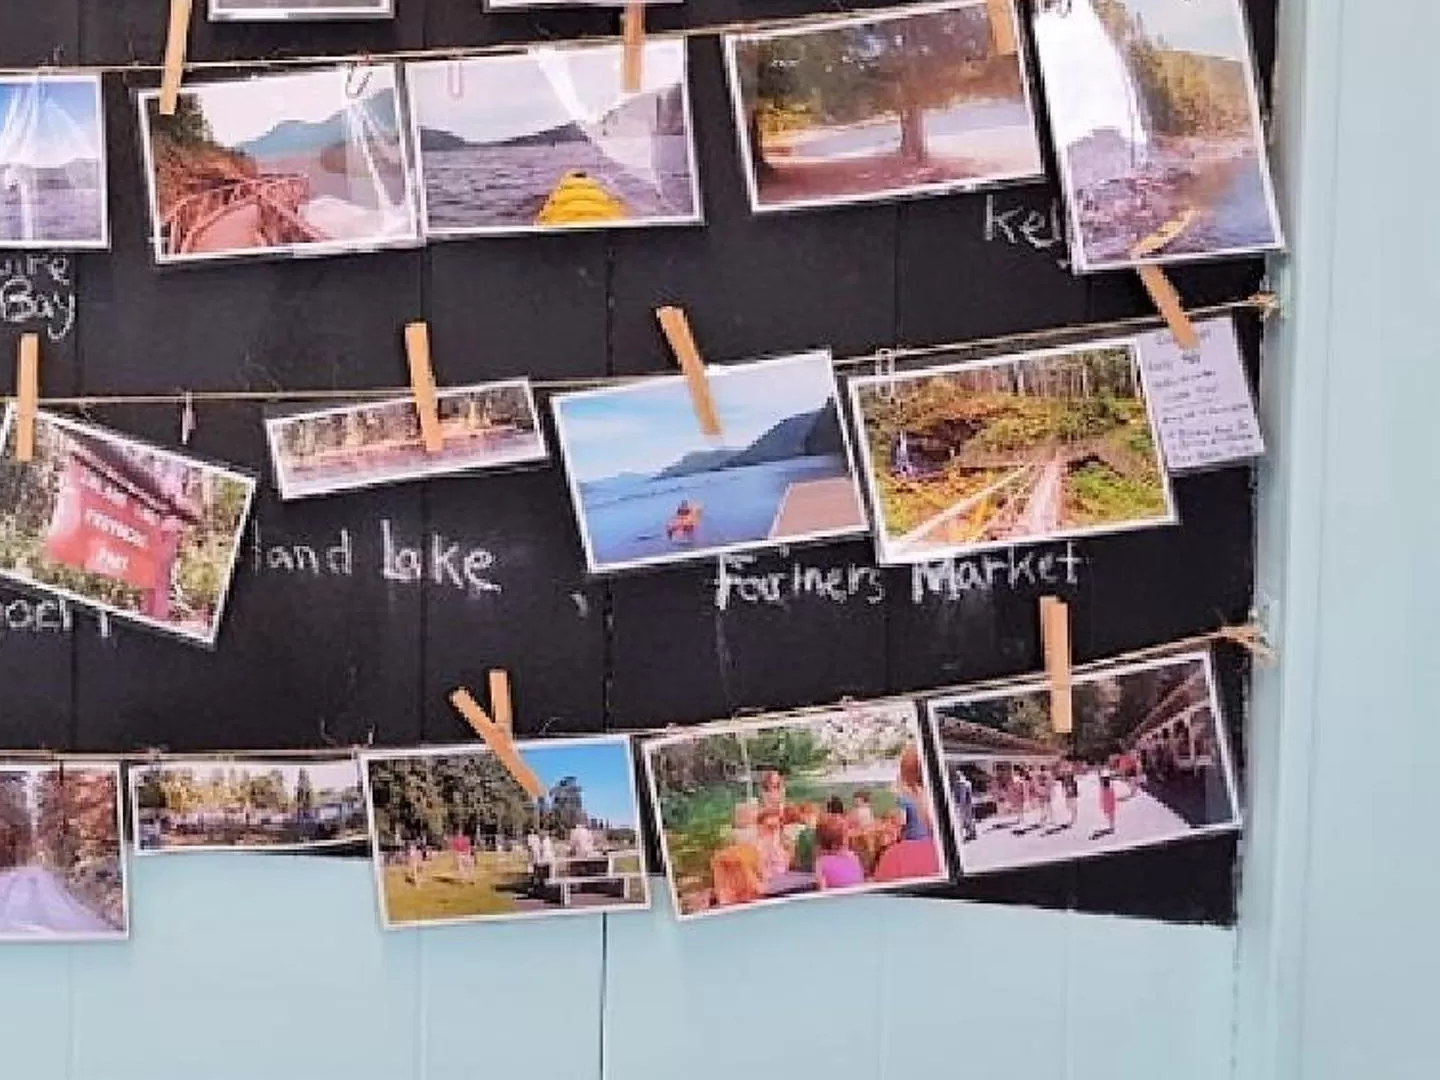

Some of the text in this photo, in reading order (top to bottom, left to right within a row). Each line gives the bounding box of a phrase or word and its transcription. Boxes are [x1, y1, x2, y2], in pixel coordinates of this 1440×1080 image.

[0, 276, 77, 341] Bay
[251, 518, 352, 577] land
[910, 540, 1086, 605] Market
